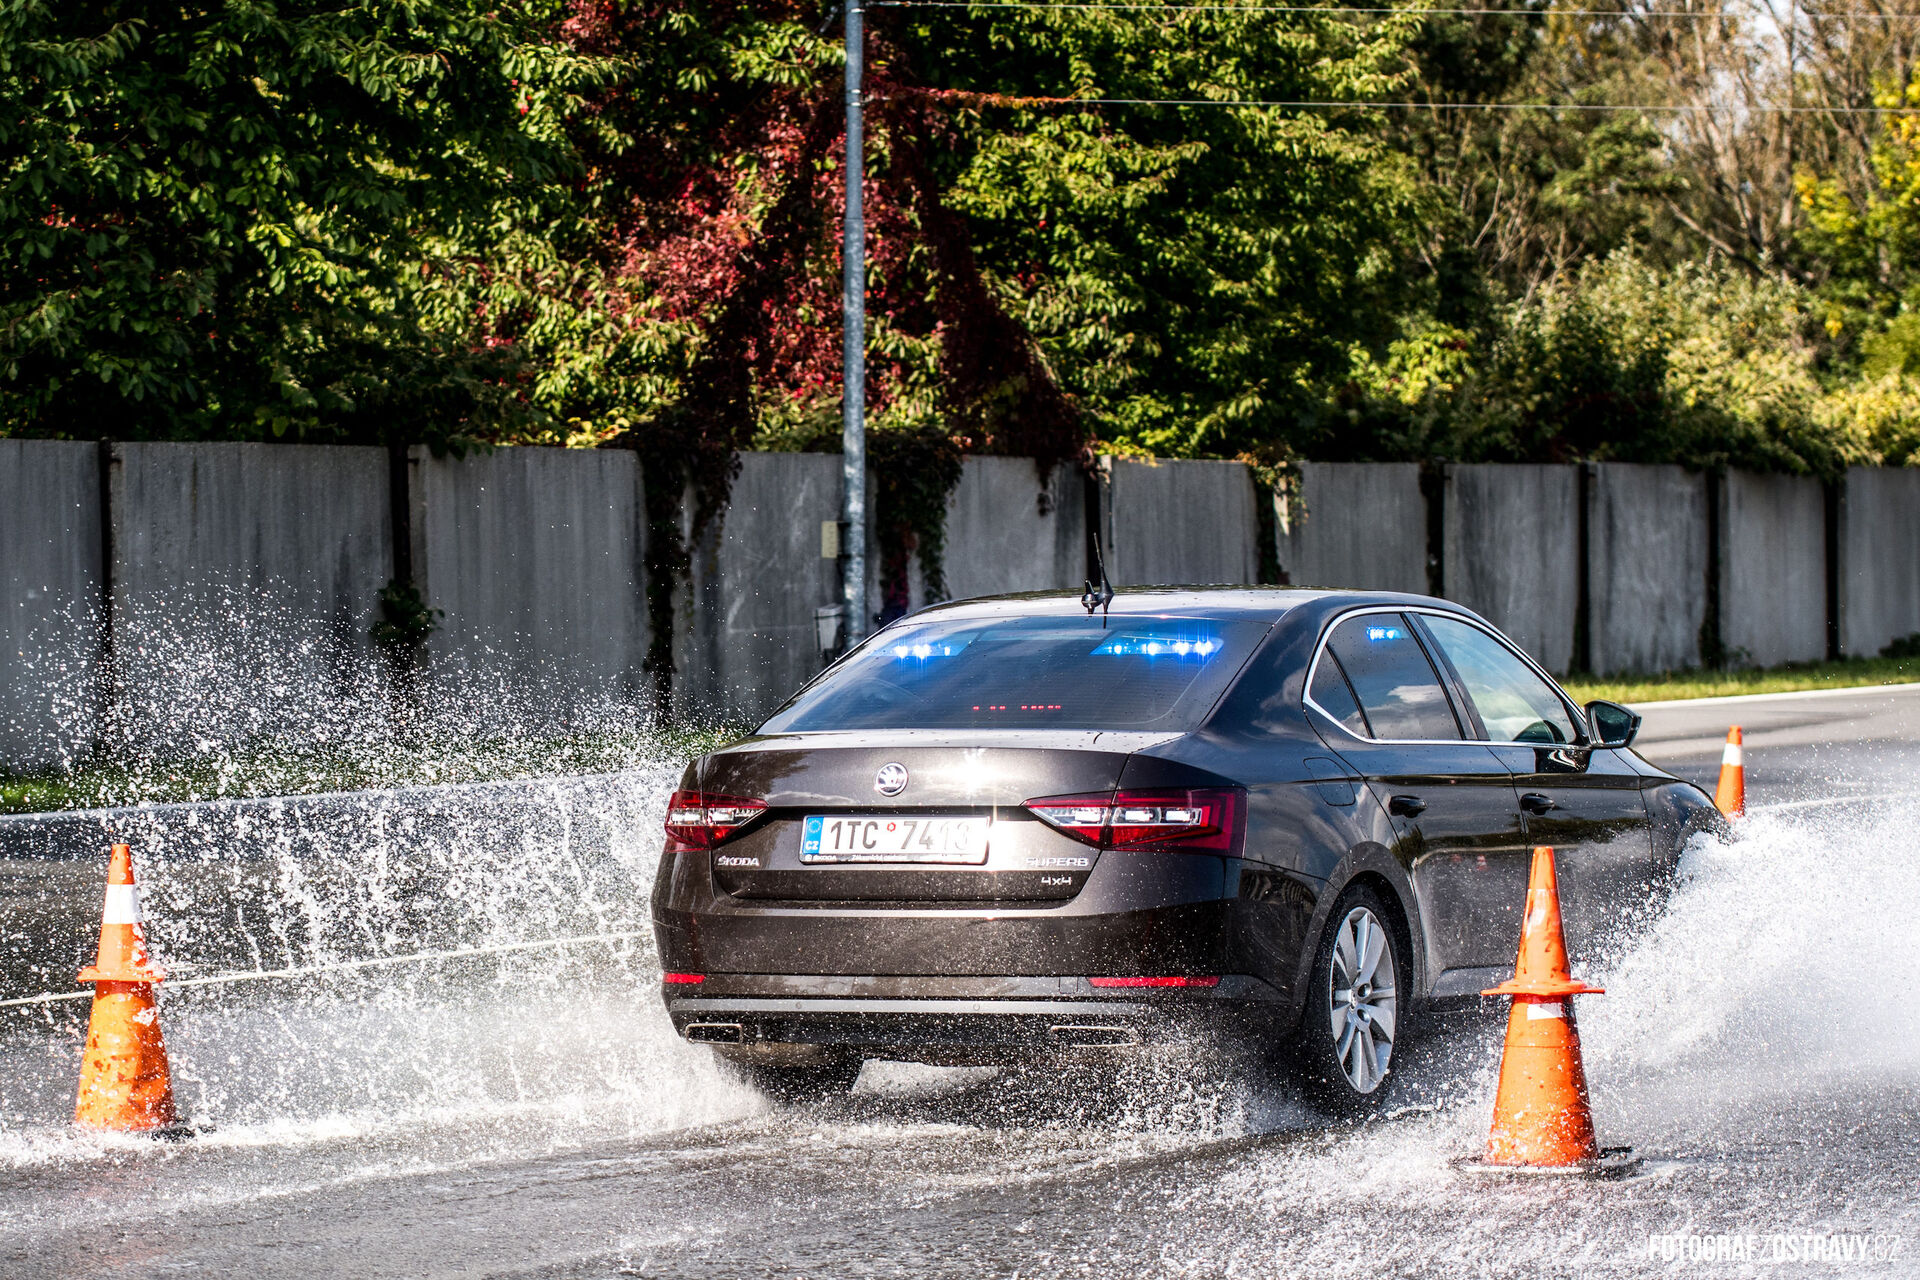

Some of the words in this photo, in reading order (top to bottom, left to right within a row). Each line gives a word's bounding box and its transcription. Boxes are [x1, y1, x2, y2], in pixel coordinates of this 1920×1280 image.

[830, 820, 879, 850] 1TC
[805, 840, 819, 850] CZ
[717, 855, 760, 866] ŠKODA
[1025, 857, 1089, 867] SUPERB
